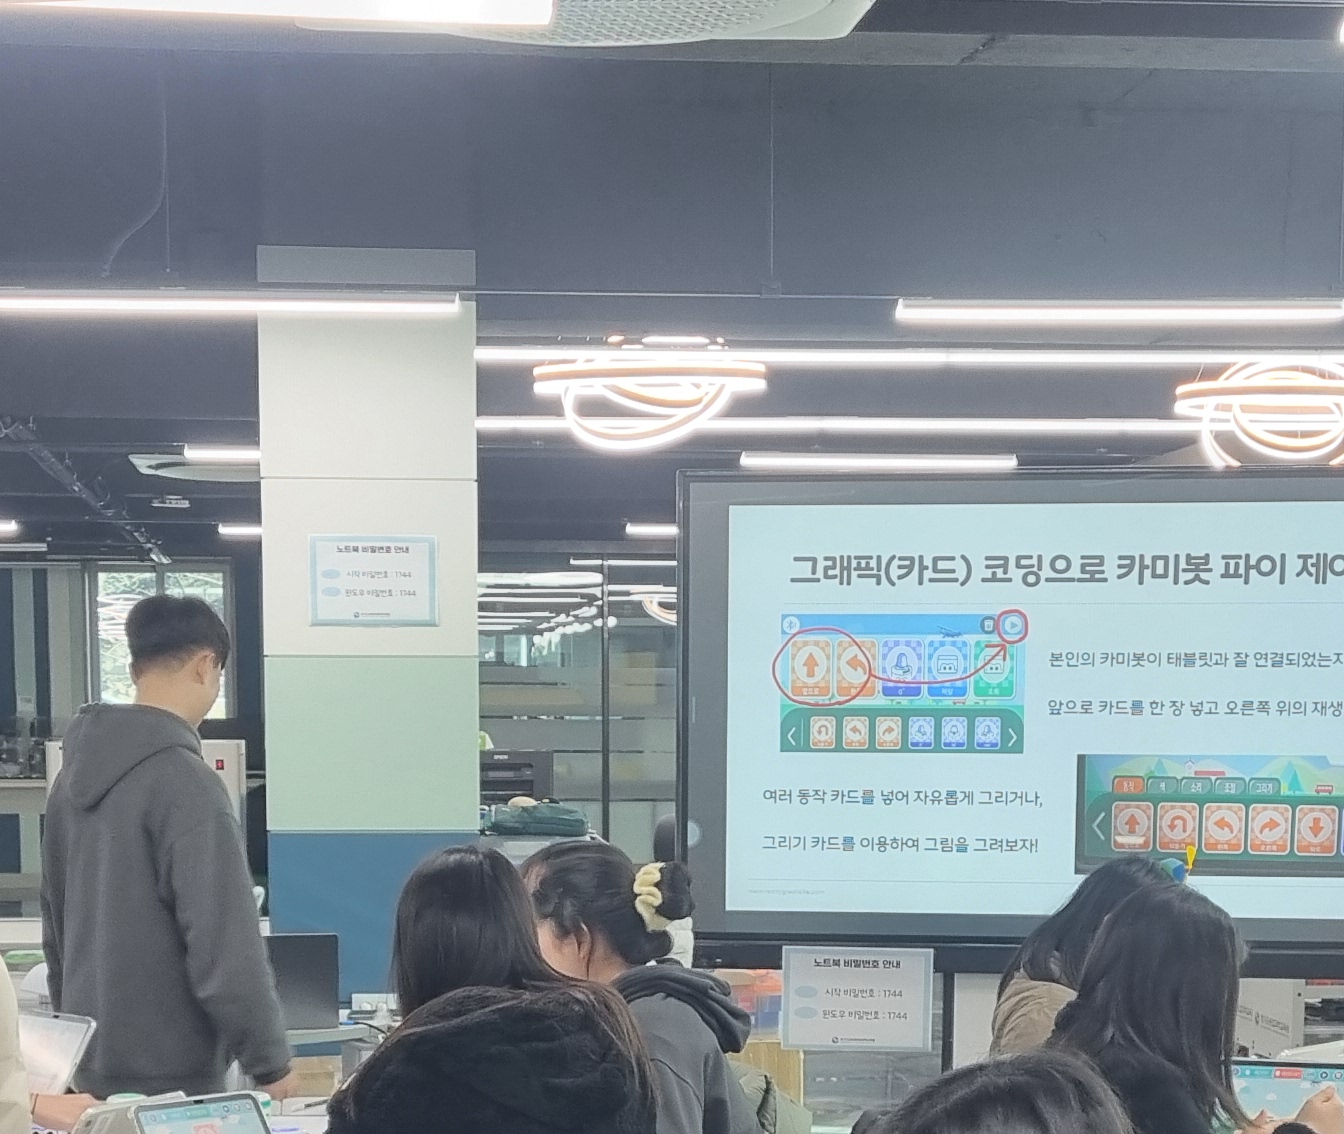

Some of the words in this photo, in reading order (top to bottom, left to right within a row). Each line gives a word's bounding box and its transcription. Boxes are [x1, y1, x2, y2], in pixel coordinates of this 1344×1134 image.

[393, 545, 410, 554] 안내
[789, 553, 973, 588] 그래픽(카드)
[980, 553, 1109, 588] 코딩으로
[1116, 552, 1214, 586] 카미봇
[1219, 552, 1287, 586] 파이
[1048, 651, 1096, 668] 본인의
[1099, 651, 1162, 668] 카미봇이
[1166, 651, 1229, 668] 태블릿과
[1232, 651, 1250, 668] 잘
[1047, 699, 1095, 716] 앞으로
[1097, 699, 1146, 716] 카드를
[1148, 699, 1166, 716] 한
[1168, 699, 1186, 717] 장
[1189, 700, 1220, 717] 넣고
[1223, 700, 1272, 717] 오른쪽
[1275, 700, 1307, 717] 위의
[1310, 700, 1344, 718] 재생
[762, 788, 793, 805] 여러
[795, 788, 827, 805] 동작
[829, 788, 876, 806] 카드를
[880, 789, 910, 807] 넣어
[912, 789, 975, 807] 자유롭게
[977, 790, 1044, 809] 그리거나,
[761, 835, 807, 851] 그리기
[810, 835, 856, 852] 카드를
[859, 835, 920, 853] 이용하여
[923, 836, 970, 854] 그림을
[972, 837, 1040, 854] 그려보자!
[813, 957, 841, 968] 노트북
[843, 958, 880, 969] 비밀번호
[882, 959, 901, 970] 안내
[824, 987, 842, 998] 시작
[843, 988, 876, 999] 비밀번호
[883, 989, 903, 998] 1744
[848, 1010, 880, 1021] 비밀번호
[887, 1011, 908, 1021] 1744
